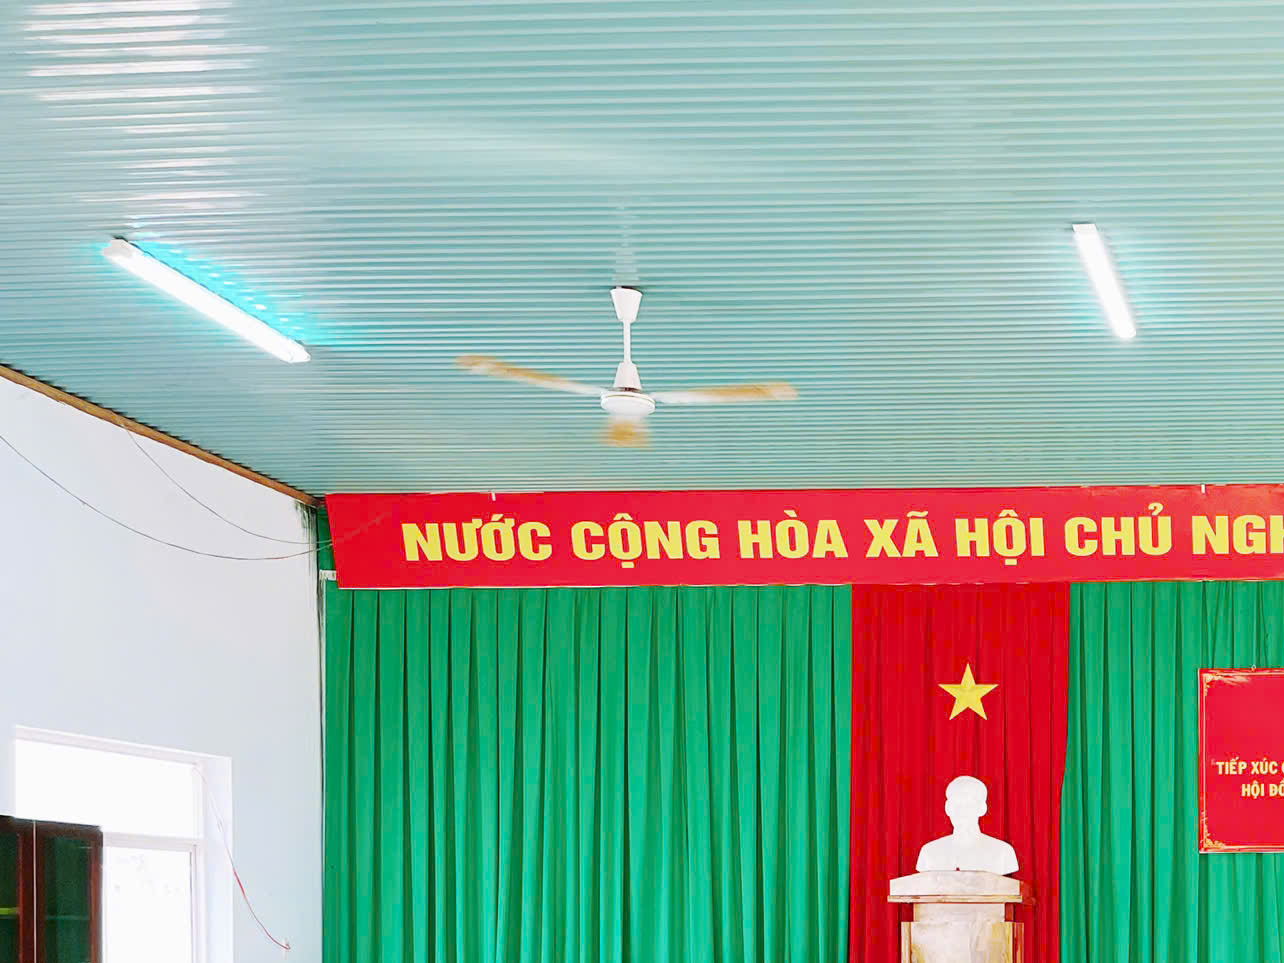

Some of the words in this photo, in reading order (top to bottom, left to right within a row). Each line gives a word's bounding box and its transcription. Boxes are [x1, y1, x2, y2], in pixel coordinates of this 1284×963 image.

[402, 513, 552, 562] NƯỚC
[572, 512, 720, 569] CỘNG
[738, 509, 848, 559] HÒA
[864, 510, 938, 558] XÃ
[956, 509, 1044, 566] HỘI
[1064, 502, 1172, 556] CHỦ
[1215, 756, 1248, 775] TIẾP
[1251, 757, 1279, 775] XÚC
[1241, 779, 1265, 799] HỘI
